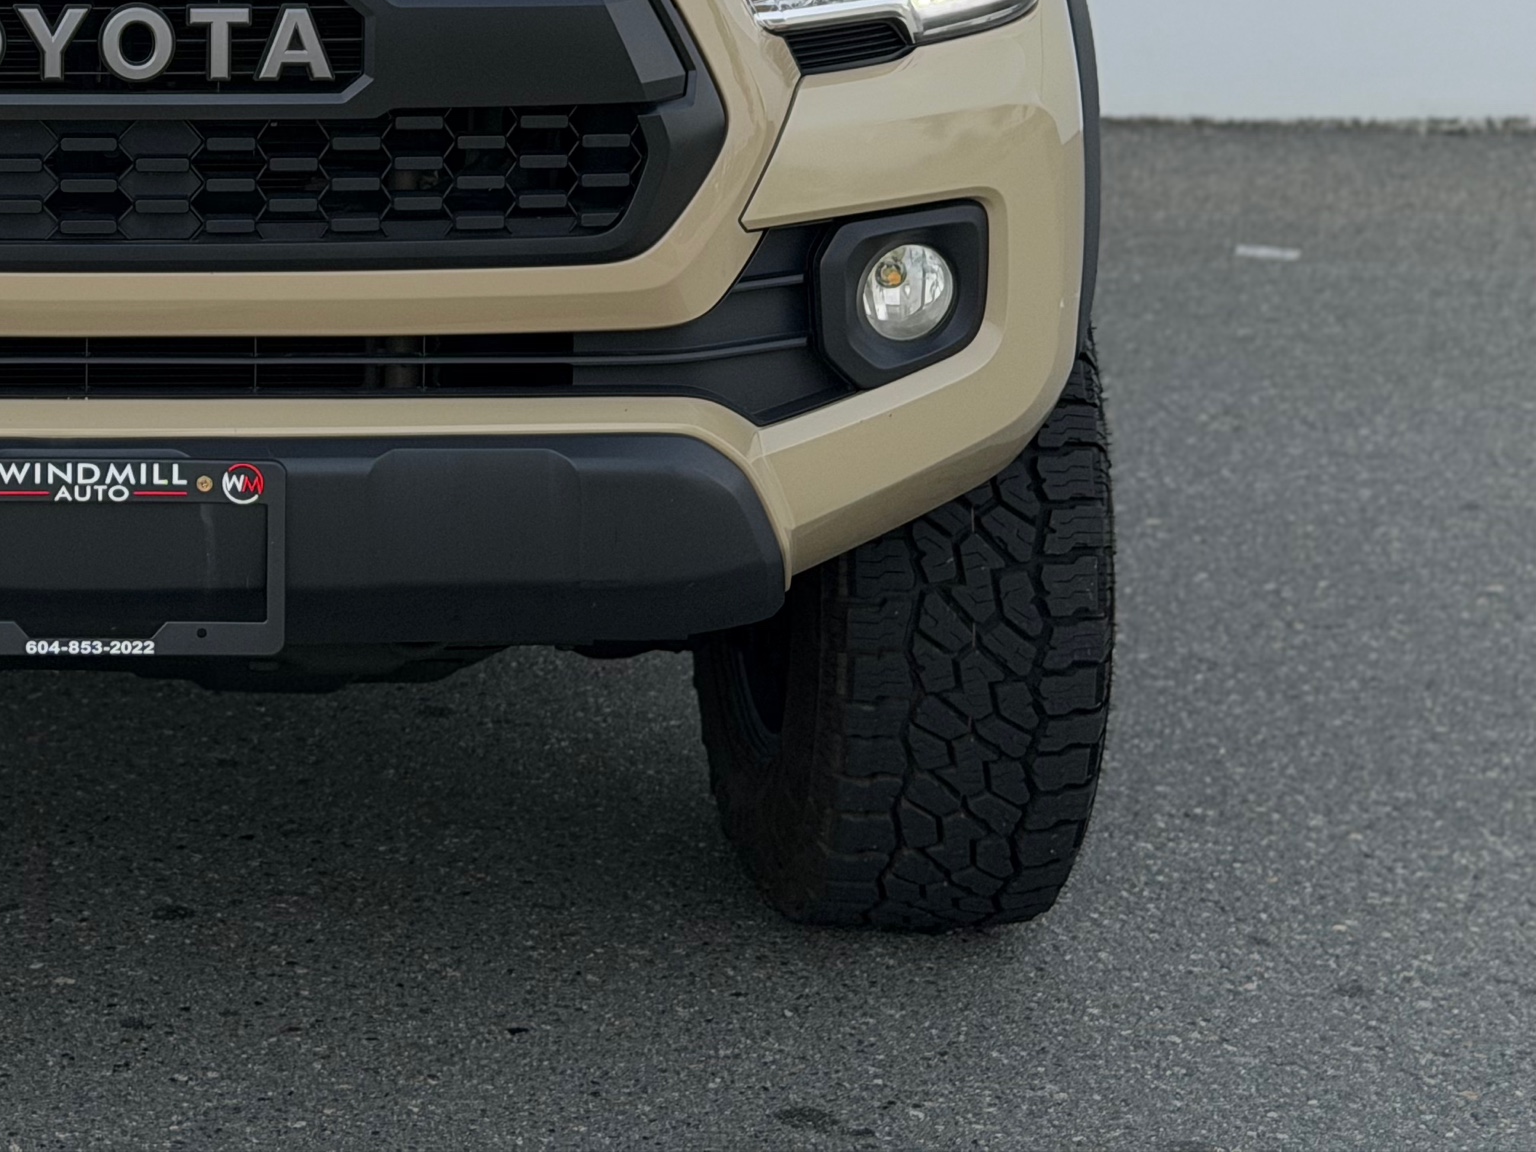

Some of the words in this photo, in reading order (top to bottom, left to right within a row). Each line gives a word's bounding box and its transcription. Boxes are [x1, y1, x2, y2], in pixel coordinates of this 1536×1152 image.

[222, 472, 264, 495] WM
[54, 485, 129, 502] AUTO
[25, 640, 155, 654] 604-853-2022
